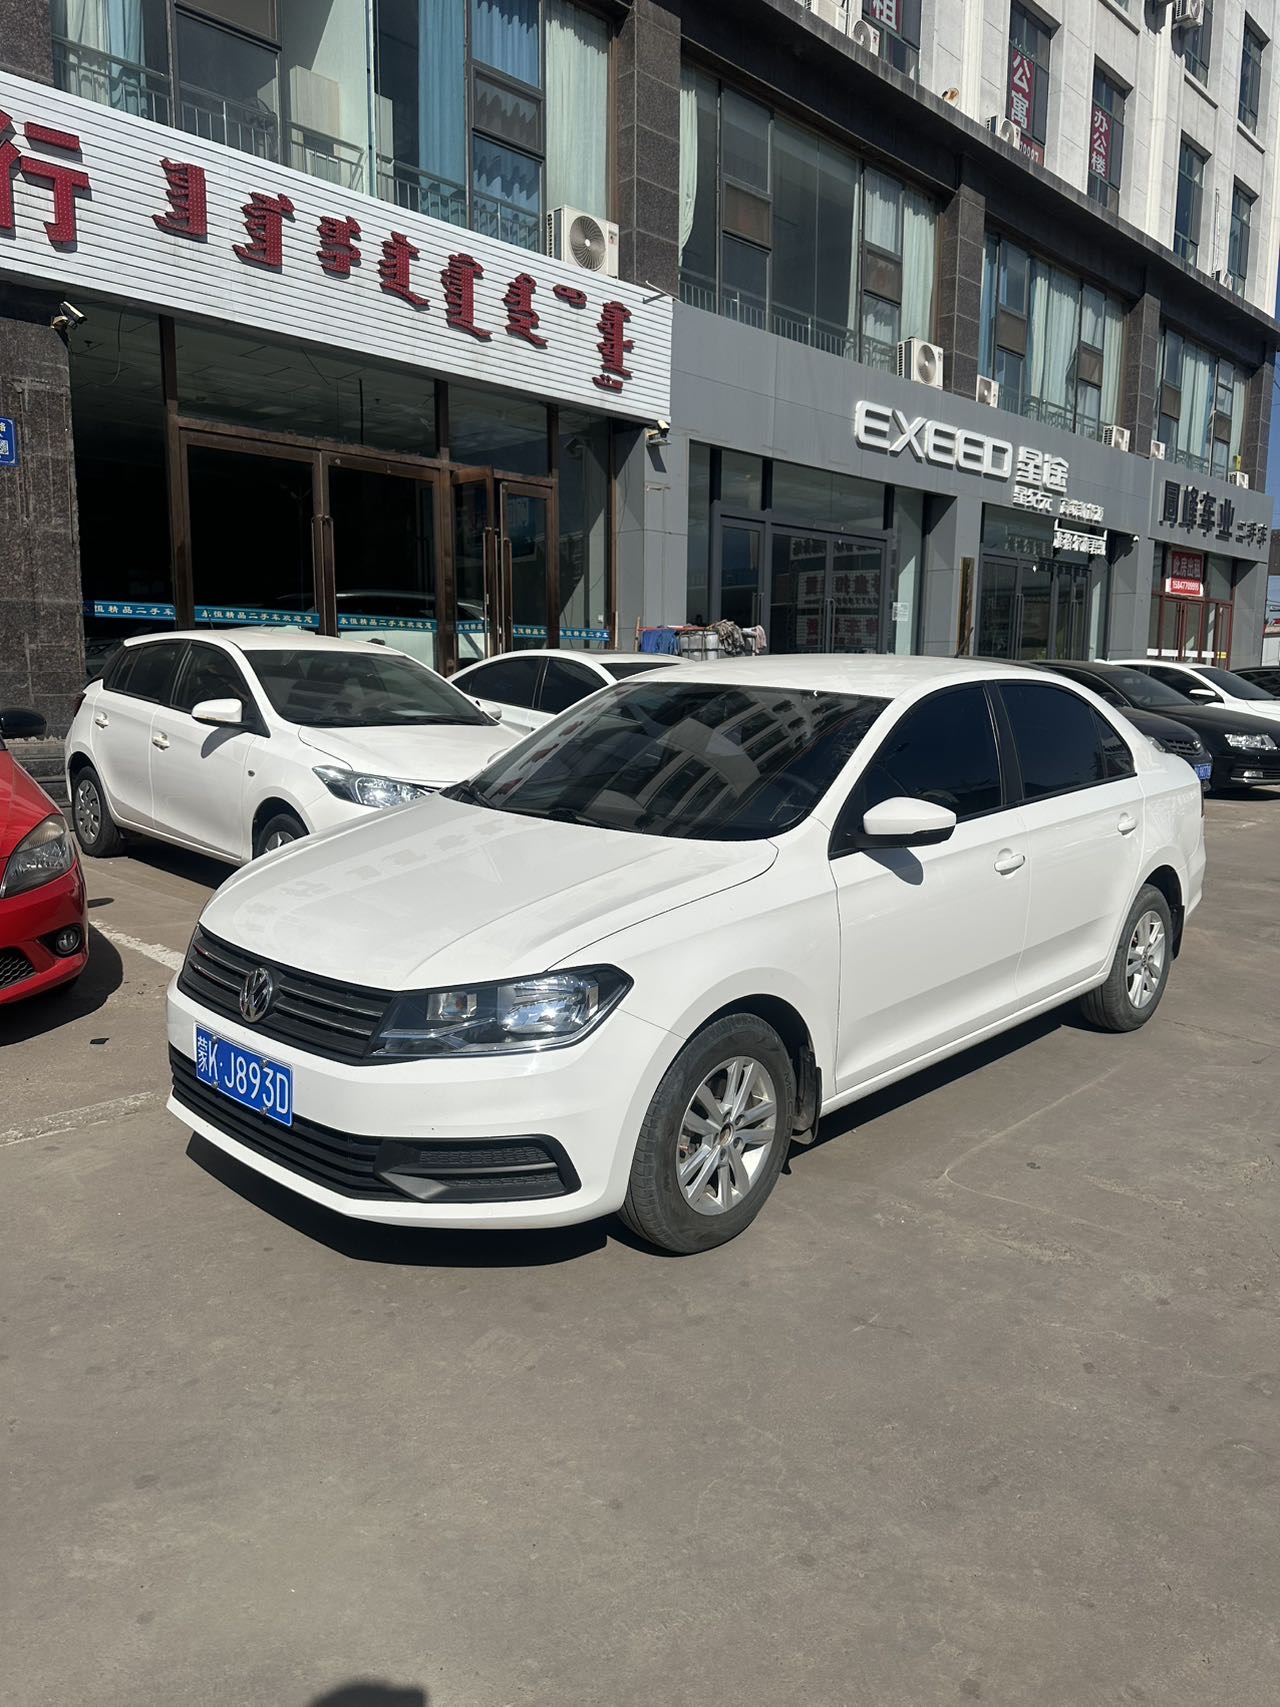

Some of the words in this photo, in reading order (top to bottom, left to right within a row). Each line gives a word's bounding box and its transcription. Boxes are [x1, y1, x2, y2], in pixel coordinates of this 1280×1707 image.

[1011, 54, 1031, 129] 公寓
[0, 110, 89, 243] 行
[1091, 110, 1108, 177] 办公楼
[854, 400, 1013, 480] EXEED
[1015, 446, 1069, 493] 星途
